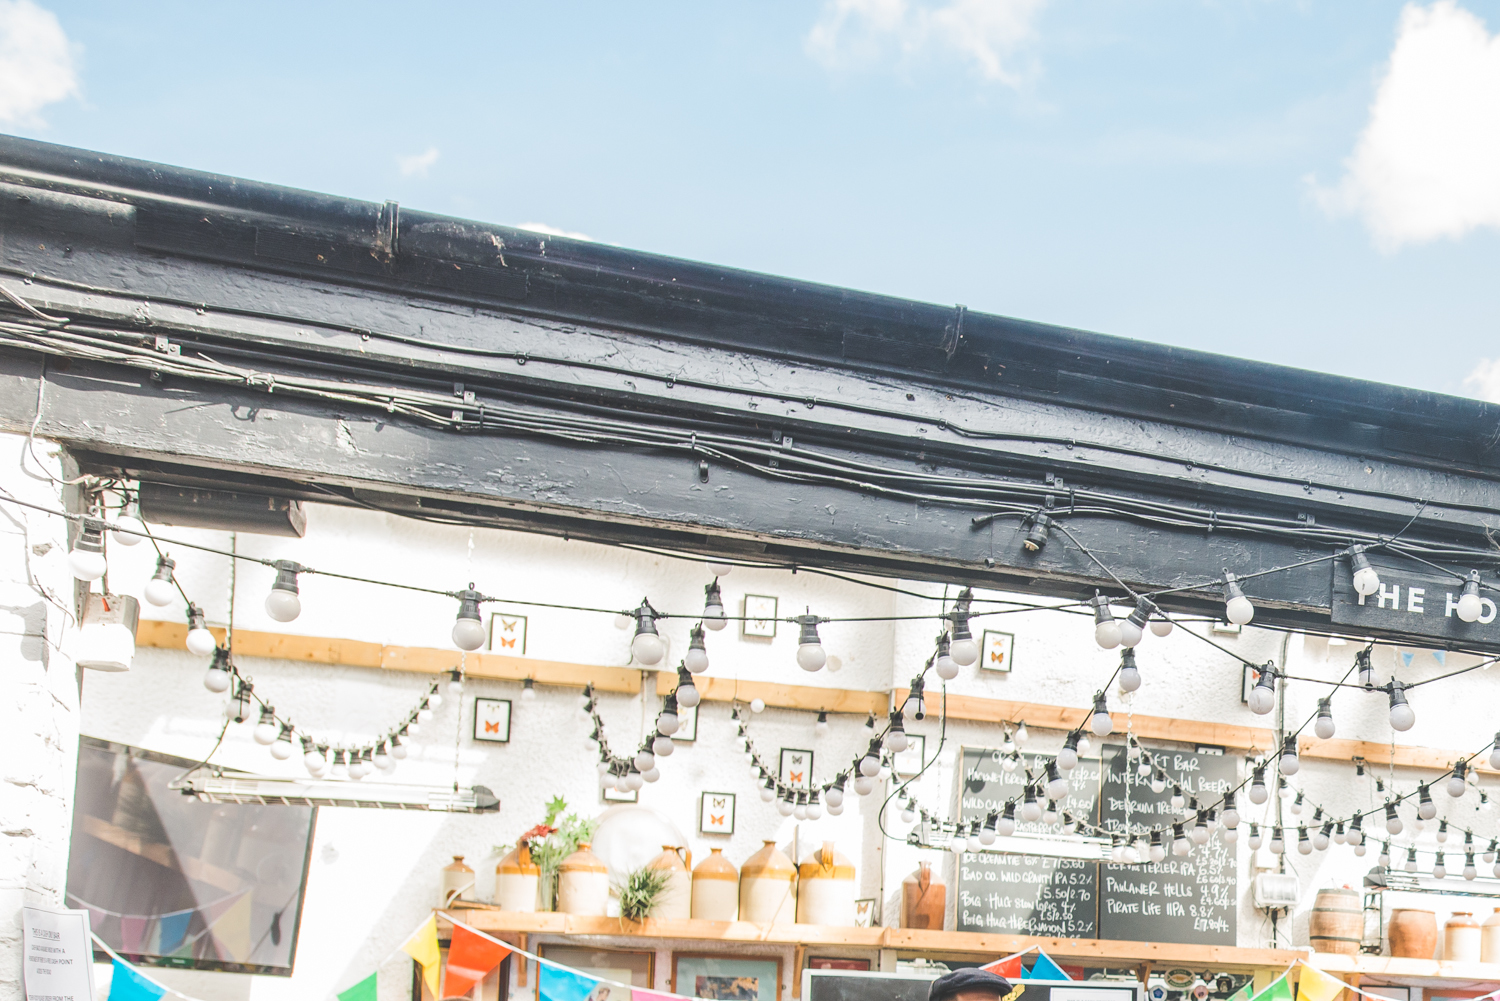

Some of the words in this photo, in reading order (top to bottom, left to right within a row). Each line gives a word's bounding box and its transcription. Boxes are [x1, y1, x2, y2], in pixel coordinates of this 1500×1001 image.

[1173, 755, 1200, 771] BAR
[1106, 877, 1160, 896] PAULANER
[1106, 898, 1139, 914] PIRATE
[1189, 904, 1214, 918] 8.8%
